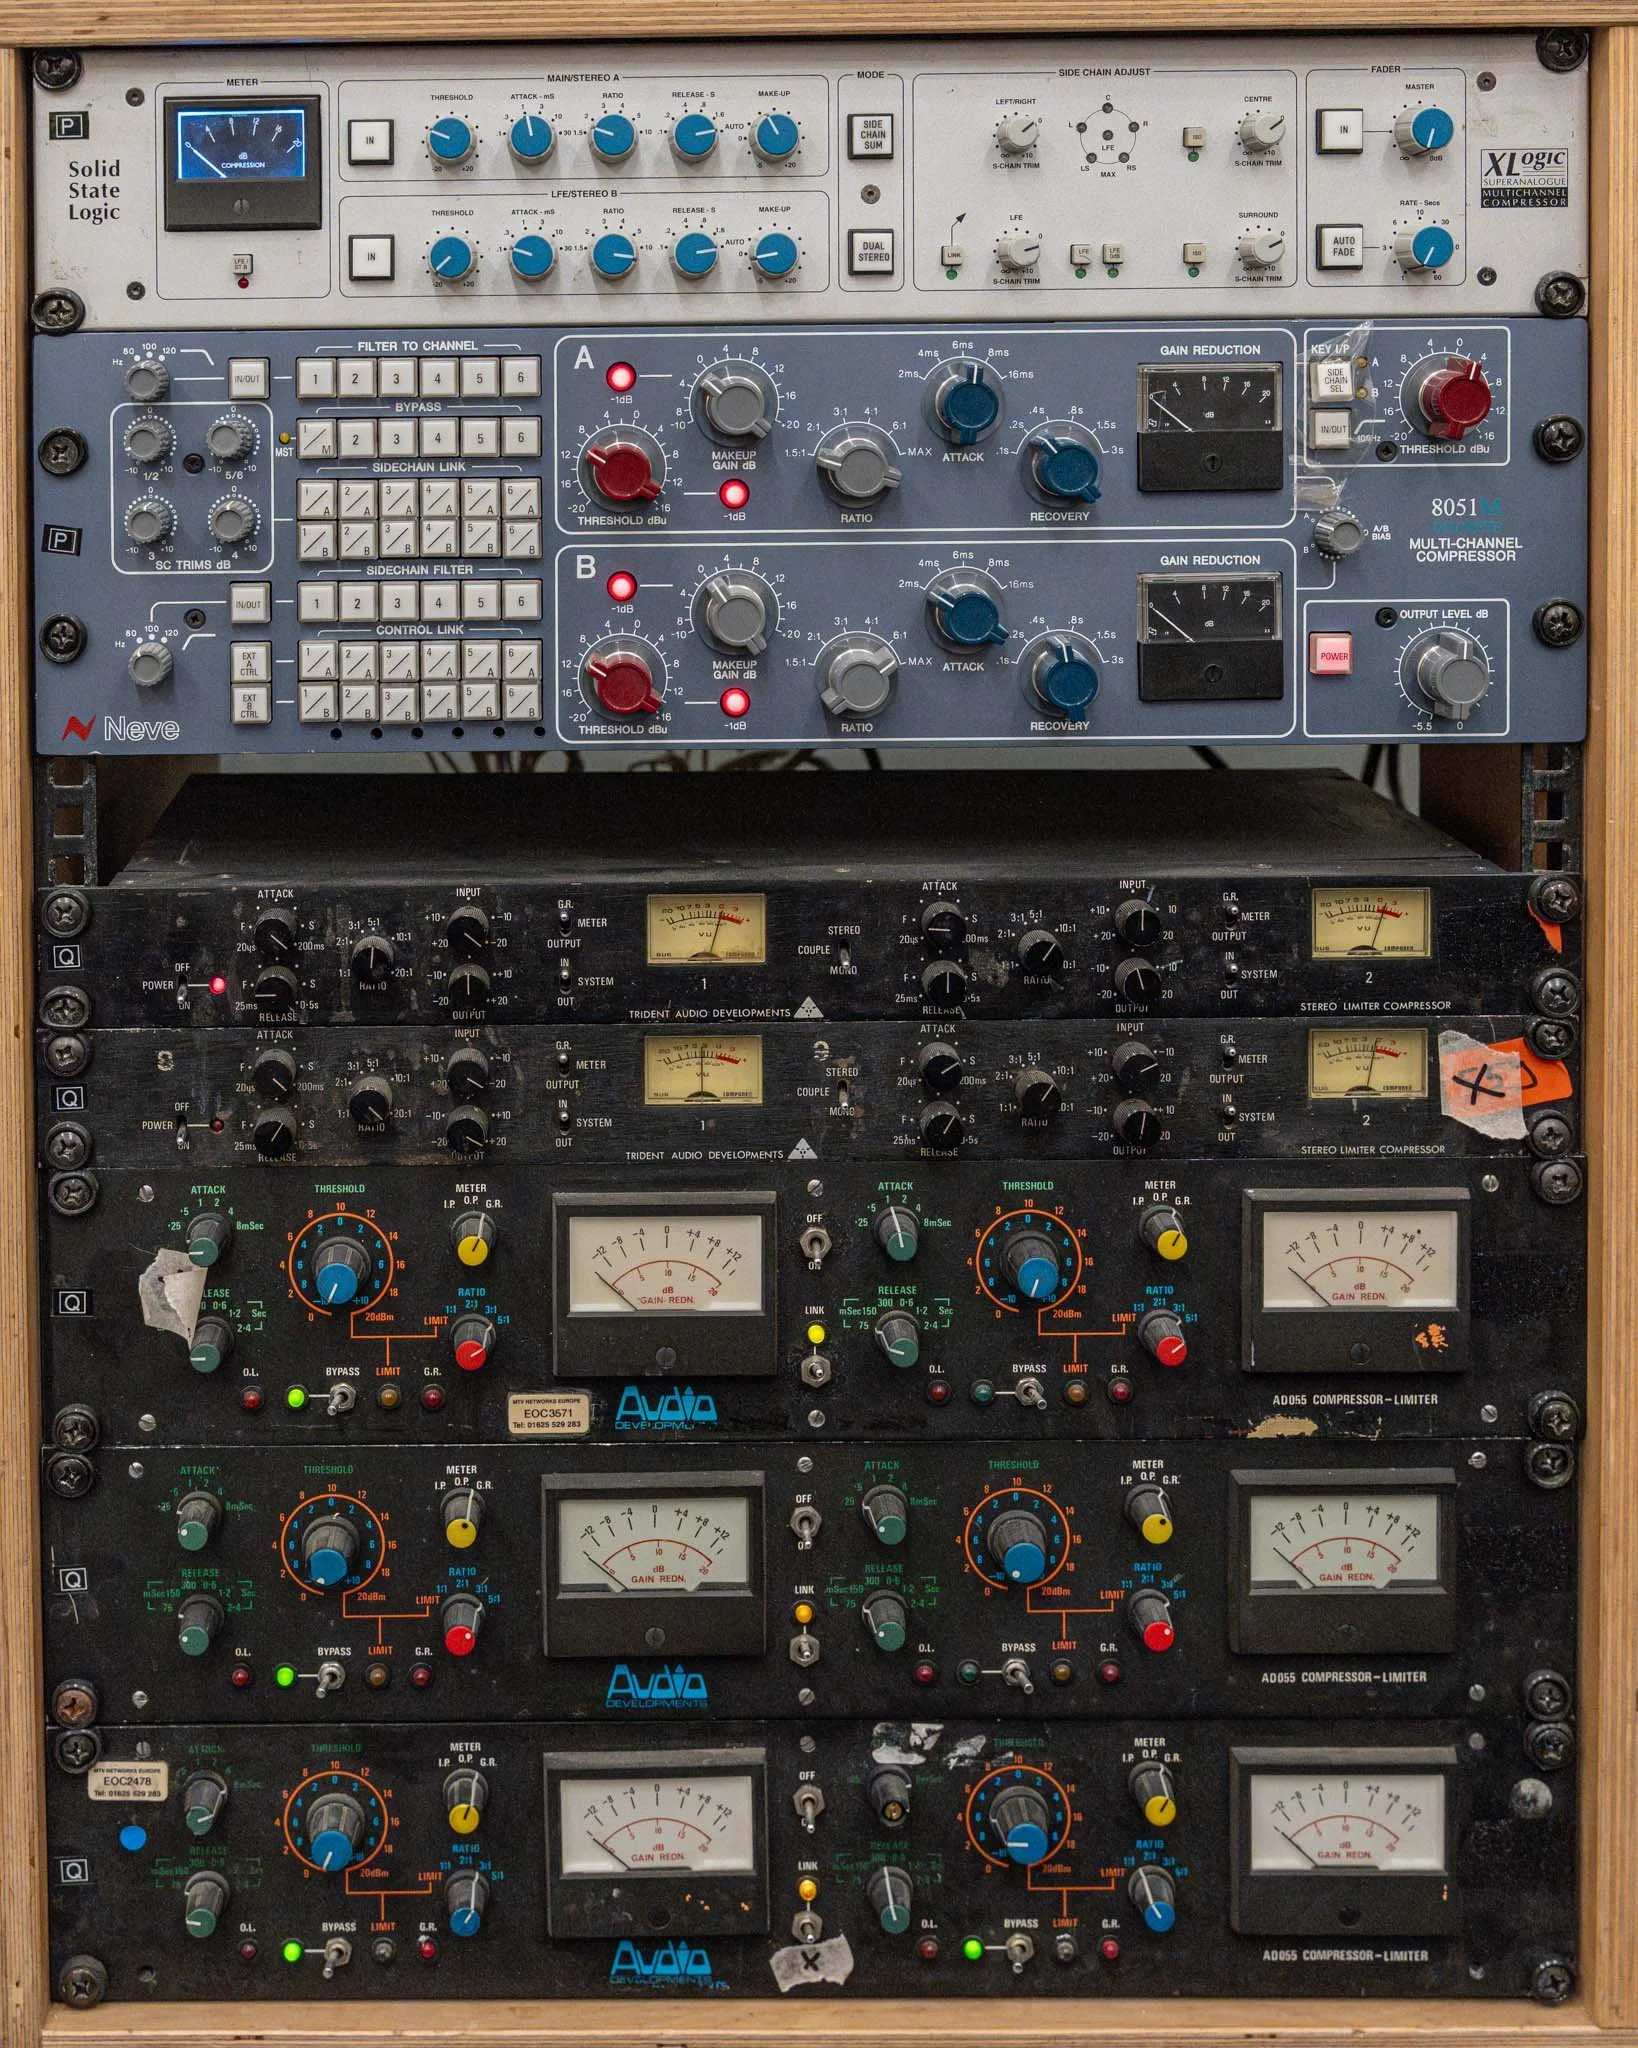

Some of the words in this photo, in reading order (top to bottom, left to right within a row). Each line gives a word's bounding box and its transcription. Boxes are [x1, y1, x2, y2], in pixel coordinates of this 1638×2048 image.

[857, 70, 886, 79] MODE
[1058, 67, 1080, 77] SIDE
[1082, 67, 1112, 77] CHAIN
[1113, 66, 1151, 77] ADJUST
[1370, 65, 1401, 74] FADER
[225, 78, 259, 87] METER
[547, 74, 606, 83] MAIN/STEREO
[610, 74, 620, 82] A
[1405, 83, 1435, 91] MASTER
[995, 97, 1037, 106] LEFT/RIGHT
[1243, 95, 1273, 103] CENTRE
[61, 118, 75, 131] P
[863, 119, 883, 129] SIDE
[1339, 125, 1349, 134] IN
[365, 135, 375, 145] IN
[860, 130, 887, 140] CHAIN
[864, 140, 883, 150] SUM
[68, 159, 121, 178] Solid
[220, 161, 266, 169] COMPRESSION
[992, 162, 1021, 170] S-CHAIN
[1021, 162, 1041, 170] TRIM
[1483, 177, 1567, 187] SUPERANALOGUE
[68, 182, 121, 200] State
[551, 190, 609, 198] LFE/STEREO
[610, 189, 618, 198] B
[1482, 188, 1567, 198] MULTICHANNEL
[1482, 198, 1567, 208] COMPRESSOR
[68, 204, 121, 225] Logic
[431, 209, 474, 217] THRESHOLD
[1237, 211, 1279, 219] SURROUND
[862, 241, 885, 251] DUAL
[1333, 236, 1356, 246] AUTO
[367, 252, 376, 262] IN
[857, 252, 890, 262] STEREO
[1333, 247, 1356, 257] FADE
[141, 343, 157, 351] 100
[357, 341, 398, 352] FILTER
[401, 341, 419, 352] TO
[422, 340, 479, 352] CHANNEL
[951, 339, 974, 349] 6ms
[1159, 344, 1190, 356] GAIN
[1192, 344, 1261, 356] REDUCTION
[1310, 344, 1333, 355] KEY
[573, 344, 595, 370] A
[517, 371, 525, 384] 6
[1008, 369, 1034, 379] 16ms
[1327, 368, 1345, 377] SIDE
[234, 374, 262, 384] IN/OUT
[351, 373, 359, 385] 2
[434, 373, 442, 385] 4
[1324, 375, 1348, 385] CHAIN
[1329, 384, 1344, 394] SEL
[395, 402, 442, 413] BYPASS
[1320, 424, 1347, 435] IN/OUT
[275, 447, 294, 457] MST
[907, 447, 933, 457] MAX
[1400, 444, 1467, 455] THRESHOLD
[1469, 443, 1490, 455] dBu
[711, 450, 757, 461] MAKEUP
[942, 452, 984, 463] ATTACK
[372, 462, 435, 473] SIDECHAIN
[439, 462, 467, 472] LINK
[712, 460, 739, 471] GAIN
[742, 460, 757, 470] dB
[577, 516, 644, 526] THRESHOLD
[647, 515, 667, 526] dBu
[840, 513, 873, 524] RATIO
[1030, 511, 1090, 522] RECOVERY
[1373, 524, 1390, 534] A/B
[1371, 532, 1392, 541] BIAS
[1409, 537, 1523, 551] MULTI-CHANNEL
[1159, 555, 1190, 566] GAIN
[1192, 554, 1261, 566] REDUCTION
[1415, 550, 1516, 563] COMPRESSOR
[155, 560, 172, 571] SC
[175, 560, 213, 570] TRIMS
[216, 559, 232, 570] dB
[366, 565, 430, 576] SIDECHAIN
[433, 564, 474, 575] FILTER
[575, 554, 597, 580] B
[1400, 609, 1440, 620] OUTPUT
[1441, 609, 1474, 620] LEVEL
[1476, 608, 1489, 619] dB
[376, 625, 434, 636] CONTROL
[437, 624, 465, 635] LINK
[242, 651, 257, 661] EXT
[1320, 651, 1349, 662] POWER
[942, 661, 985, 672] ATTACK
[239, 667, 259, 677] CTRL
[104, 715, 181, 742] Neve
[257, 889, 294, 899] ATTACK
[455, 887, 481, 898] INPUT
[577, 917, 608, 928] METER
[827, 924, 861, 936] STEREO
[547, 938, 582, 949] OUTPUT
[797, 944, 831, 955] COUPLE
[58, 948, 73, 966] Q
[142, 980, 174, 991] POWER
[577, 976, 615, 987] SYSTEM
[1300, 1001, 1338, 1012] STEREO
[1343, 1000, 1380, 1012] LIMITER
[1382, 999, 1452, 1011] COMPRESSOR
[628, 1009, 670, 1020] TRIDENT
[674, 1008, 708, 1019] AUDIO
[712, 1007, 791, 1019] DEVELOPMENTS
[919, 1023, 956, 1033] ATTACK
[1300, 1145, 1338, 1155] STEREO
[1340, 1144, 1377, 1155] LIMITER
[1378, 1144, 1446, 1155] COMPRESSOR
[625, 1150, 664, 1161] TRIDENT
[671, 1150, 703, 1161] AUDIO
[708, 1150, 784, 1161] DEVELOPMENTS
[190, 1185, 226, 1195] ATTACK
[314, 1184, 366, 1194] THRESHOLD
[455, 1183, 487, 1193] METER
[1002, 1181, 1054, 1191] THRESHOLD
[806, 1214, 823, 1224] OFF
[457, 1287, 486, 1298] RATIO
[877, 1285, 918, 1296] RELEASE
[804, 1305, 825, 1316] LINK
[1052, 1309, 1082, 1320] 20dBm
[325, 1367, 361, 1377] BYPASS
[375, 1366, 401, 1376] LIMIT
[523, 1408, 574, 1419] EOC3571
[512, 1421, 526, 1429] Tel:
[631, 1574, 655, 1584] GAIN
[605, 1699, 708, 1709] DEVELOPMENTS
[103, 1775, 152, 1787] EOC2478
[1052, 1918, 1078, 1928] LIMIT
